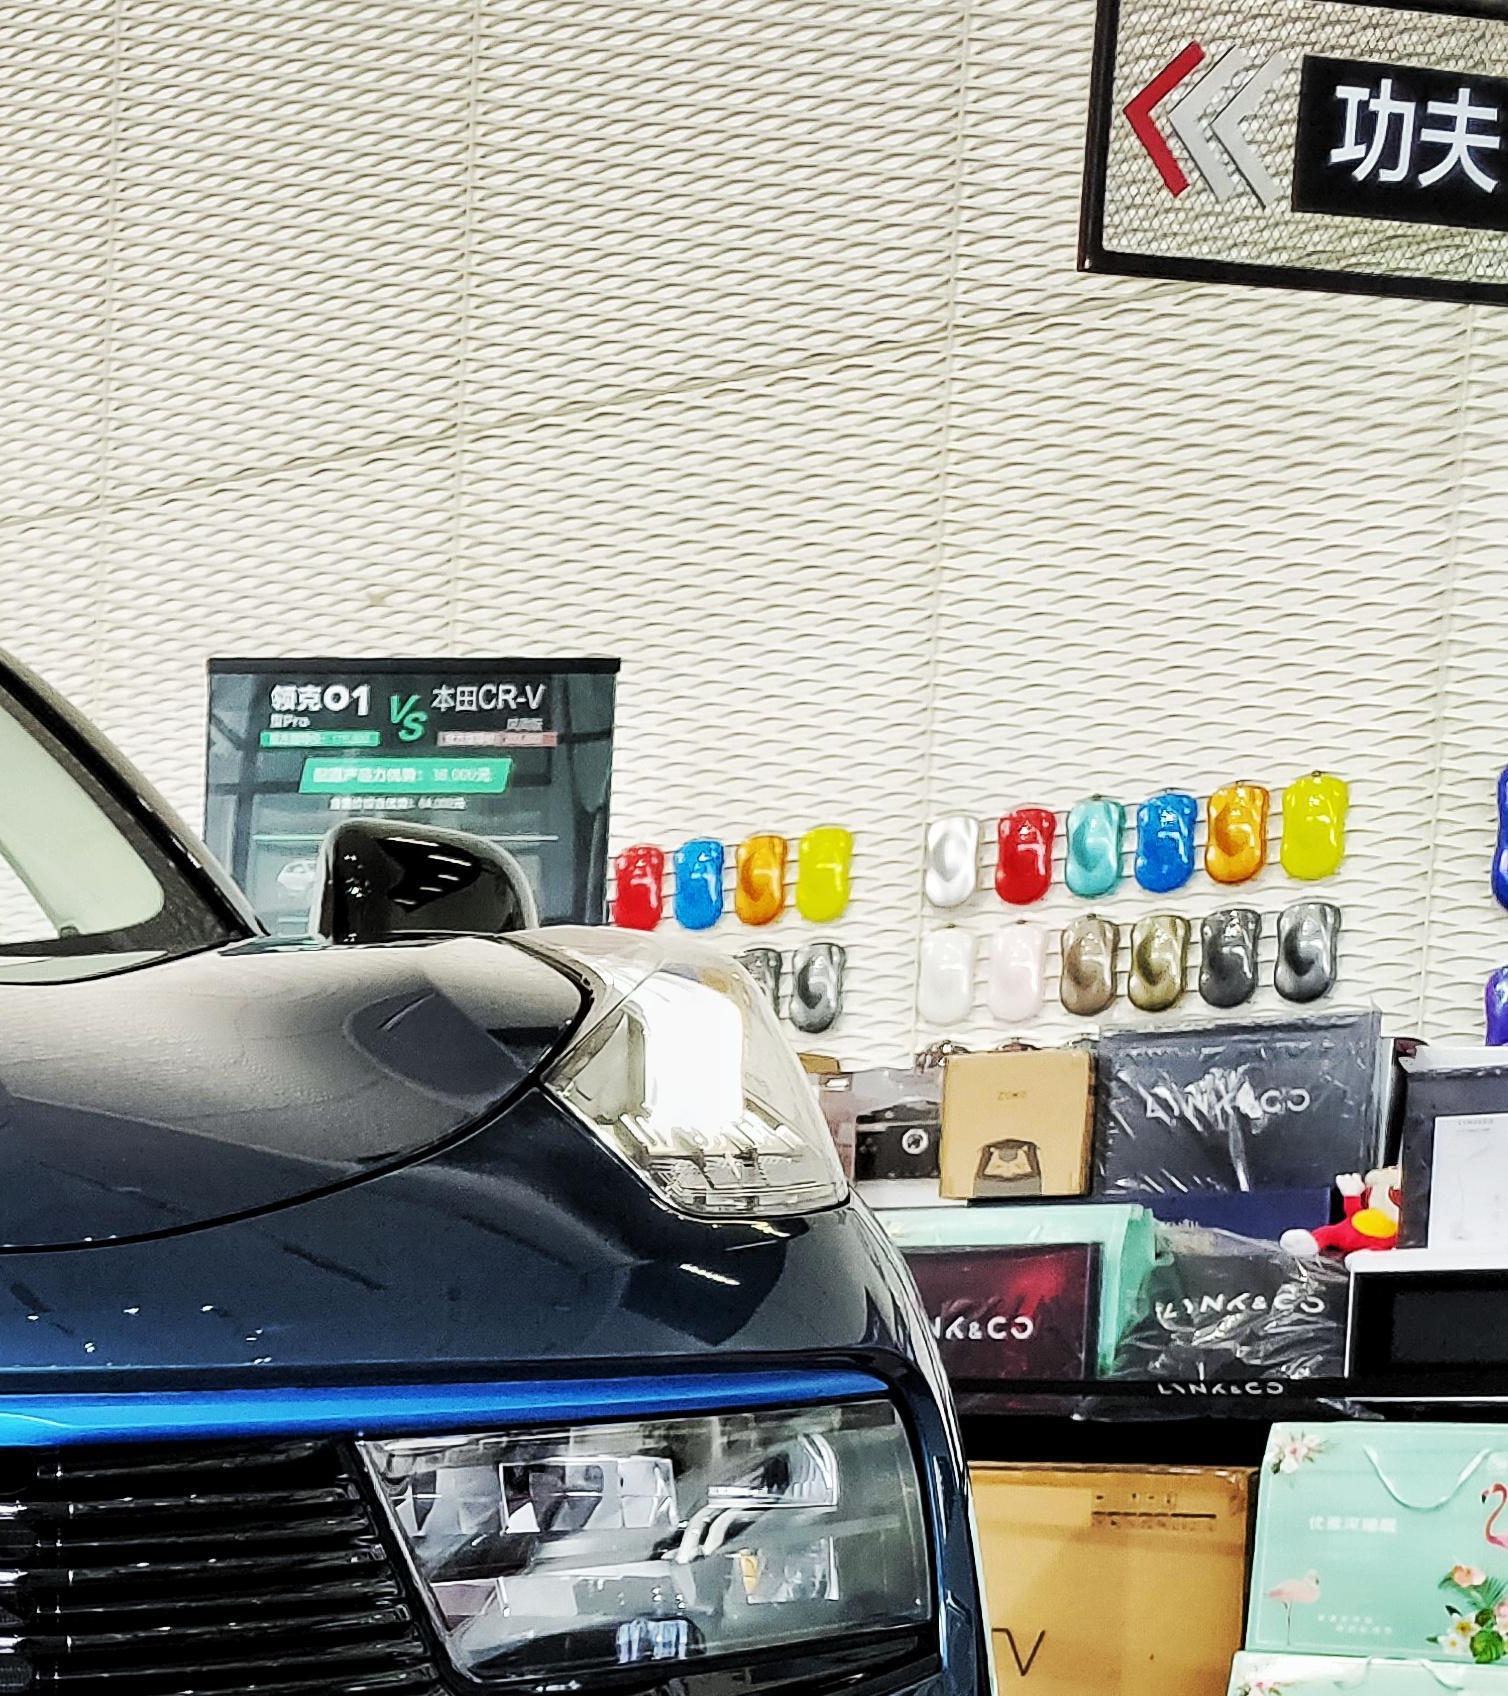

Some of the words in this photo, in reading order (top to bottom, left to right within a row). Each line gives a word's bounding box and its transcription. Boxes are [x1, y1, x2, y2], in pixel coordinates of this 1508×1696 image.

[1330, 78, 1501, 195] 功夫
[388, 694, 428, 742] VS
[431, 684, 546, 712] 本田CR-V
